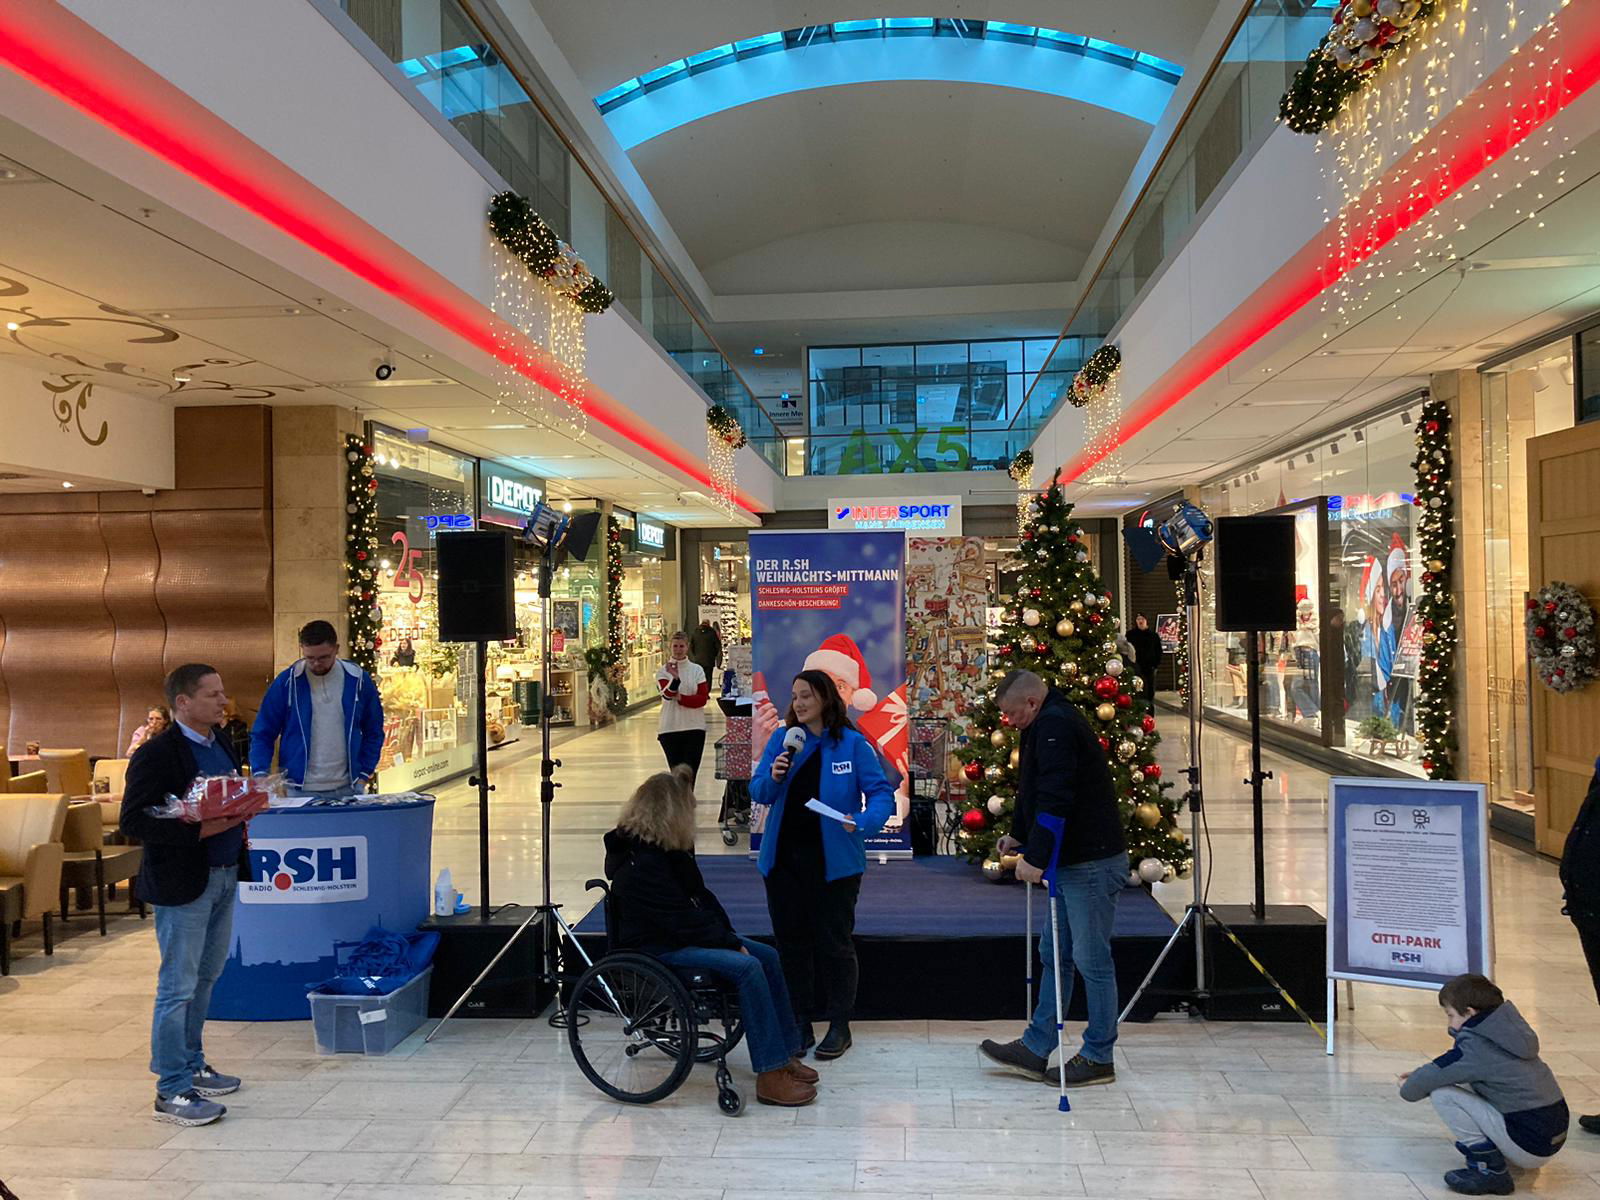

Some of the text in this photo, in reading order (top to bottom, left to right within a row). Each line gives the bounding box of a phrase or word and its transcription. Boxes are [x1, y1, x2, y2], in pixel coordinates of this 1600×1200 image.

[838, 426, 969, 474] AX5
[491, 475, 542, 512] DEPOT
[851, 504, 951, 520] INTERSPORT
[641, 523, 665, 545] DEPOT
[391, 531, 424, 605] 25
[756, 558, 810, 571] DER R.SH
[756, 569, 899, 582] WEIHNACHTS-MITTMANN
[758, 585, 823, 595] SCHLESWIG-HOLSTEINS
[758, 599, 839, 608] DANKESCHÖN-BESCHERUNG!
[390, 627, 426, 641] DEPOT
[249, 846, 357, 884] RSH
[293, 883, 357, 892] SCHLESWIG-HOLSTEIN
[1371, 932, 1442, 949] CITTI-PARK
[1391, 951, 1421, 963] RSH
